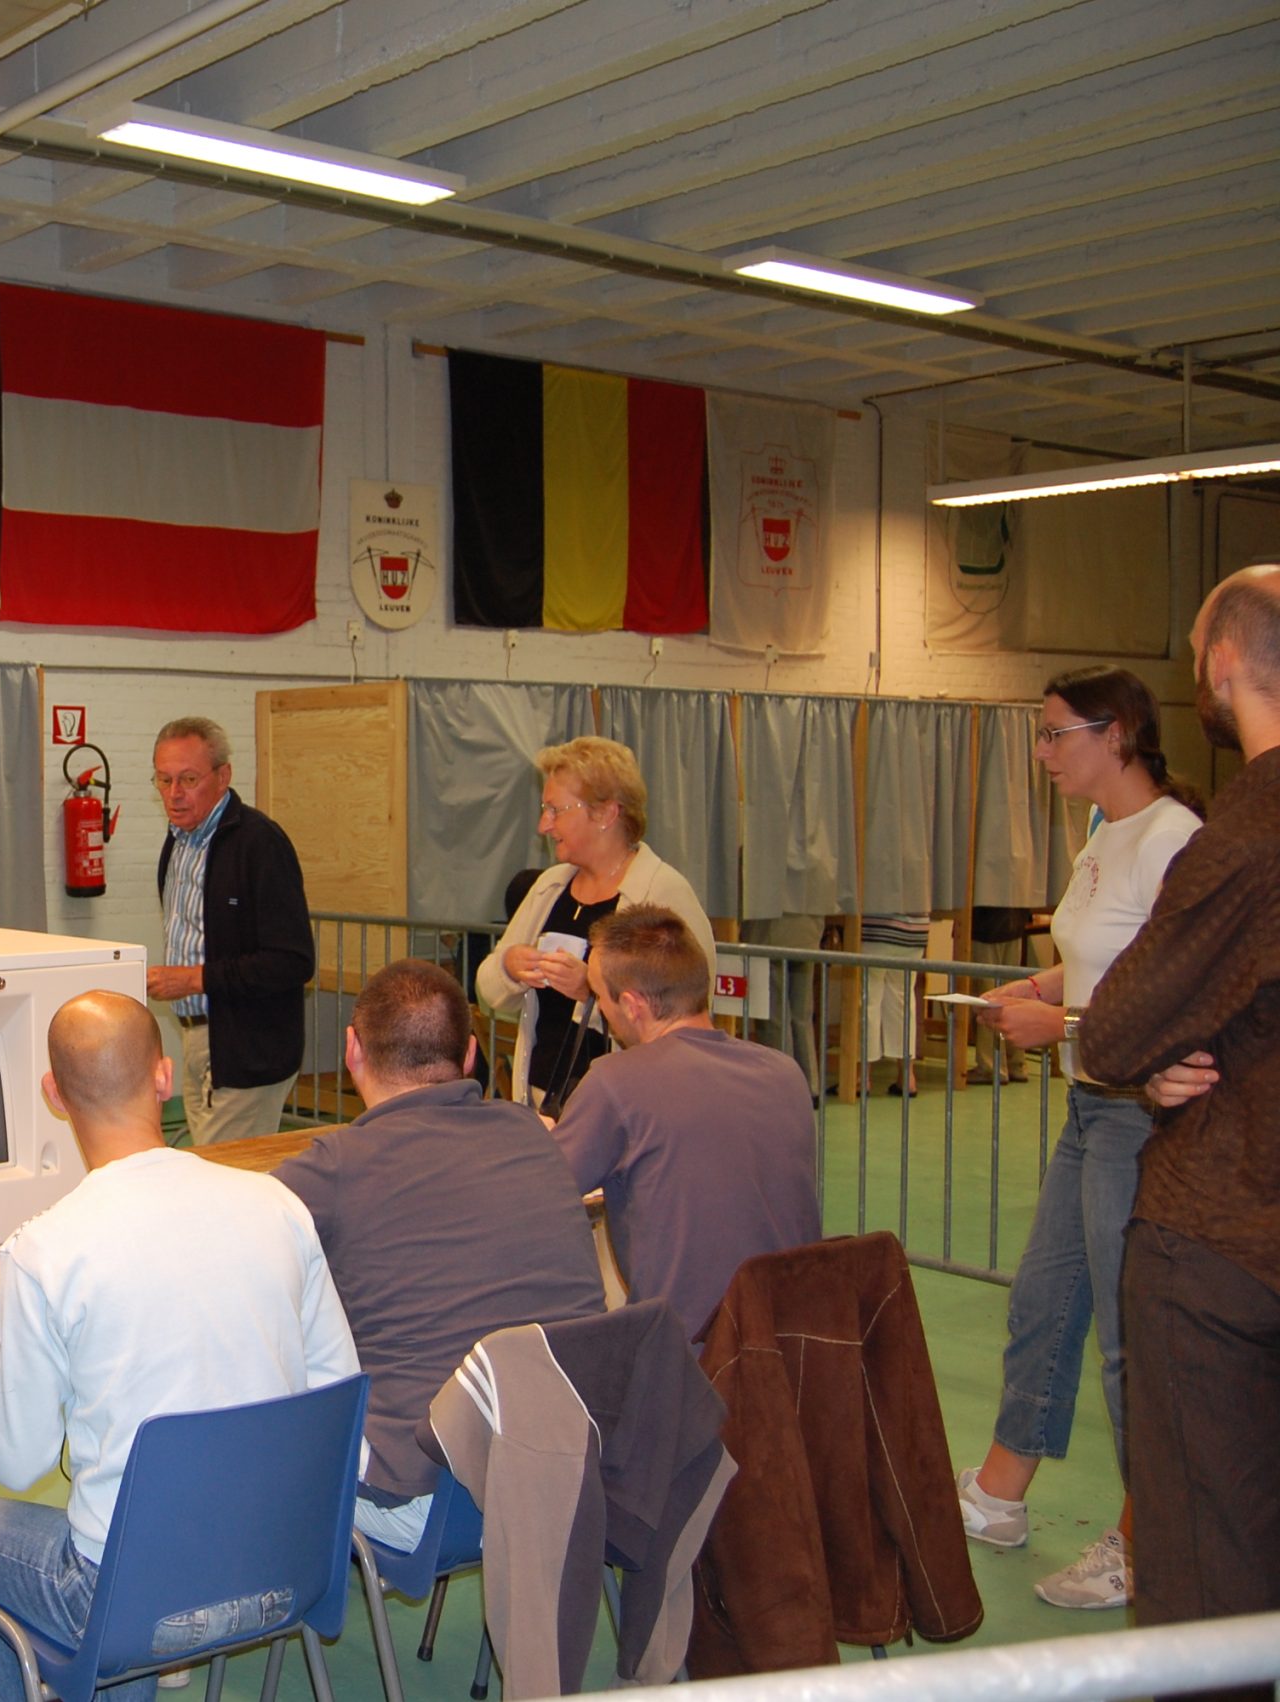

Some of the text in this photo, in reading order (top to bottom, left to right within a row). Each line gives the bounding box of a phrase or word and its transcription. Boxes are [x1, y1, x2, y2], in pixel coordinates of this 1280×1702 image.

[366, 514, 420, 528] KONINKLIJKE
[382, 571, 407, 586] HUZ
[379, 604, 411, 613] LEUVEN
